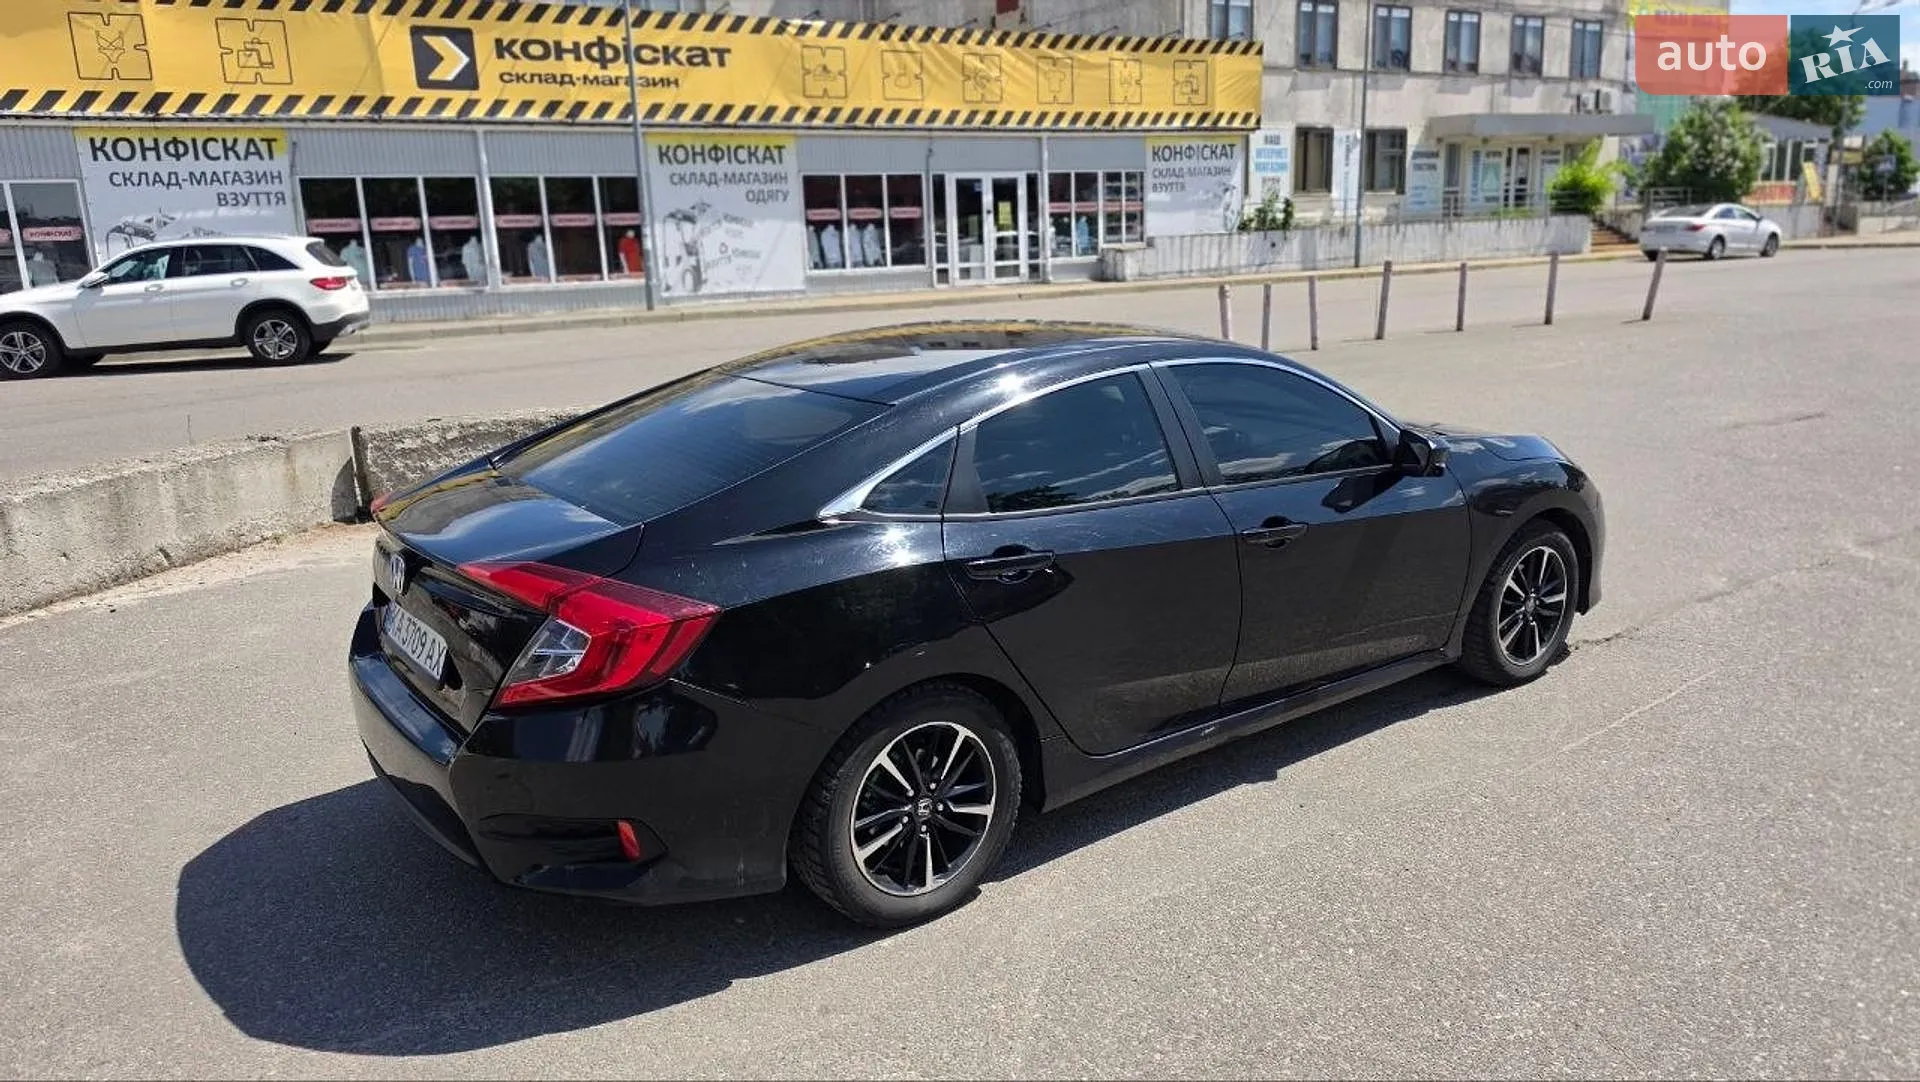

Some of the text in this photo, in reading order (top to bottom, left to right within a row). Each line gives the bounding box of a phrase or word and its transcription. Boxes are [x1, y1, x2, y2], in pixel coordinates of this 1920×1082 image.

[89, 136, 278, 162] КОНФІСКАТ
[658, 143, 786, 166] КОНФІСКАТ
[1152, 144, 1237, 162] КОНФІСКАТ
[109, 170, 284, 190] СКЛАД-МАГАЗИН
[669, 172, 789, 188] СКЛАД-МАГАЗИН
[1152, 166, 1232, 179] СКЛАД-МАГАЗИН
[217, 191, 286, 207] ВЗУТТЯ
[745, 189, 790, 205] ОДЯГУ
